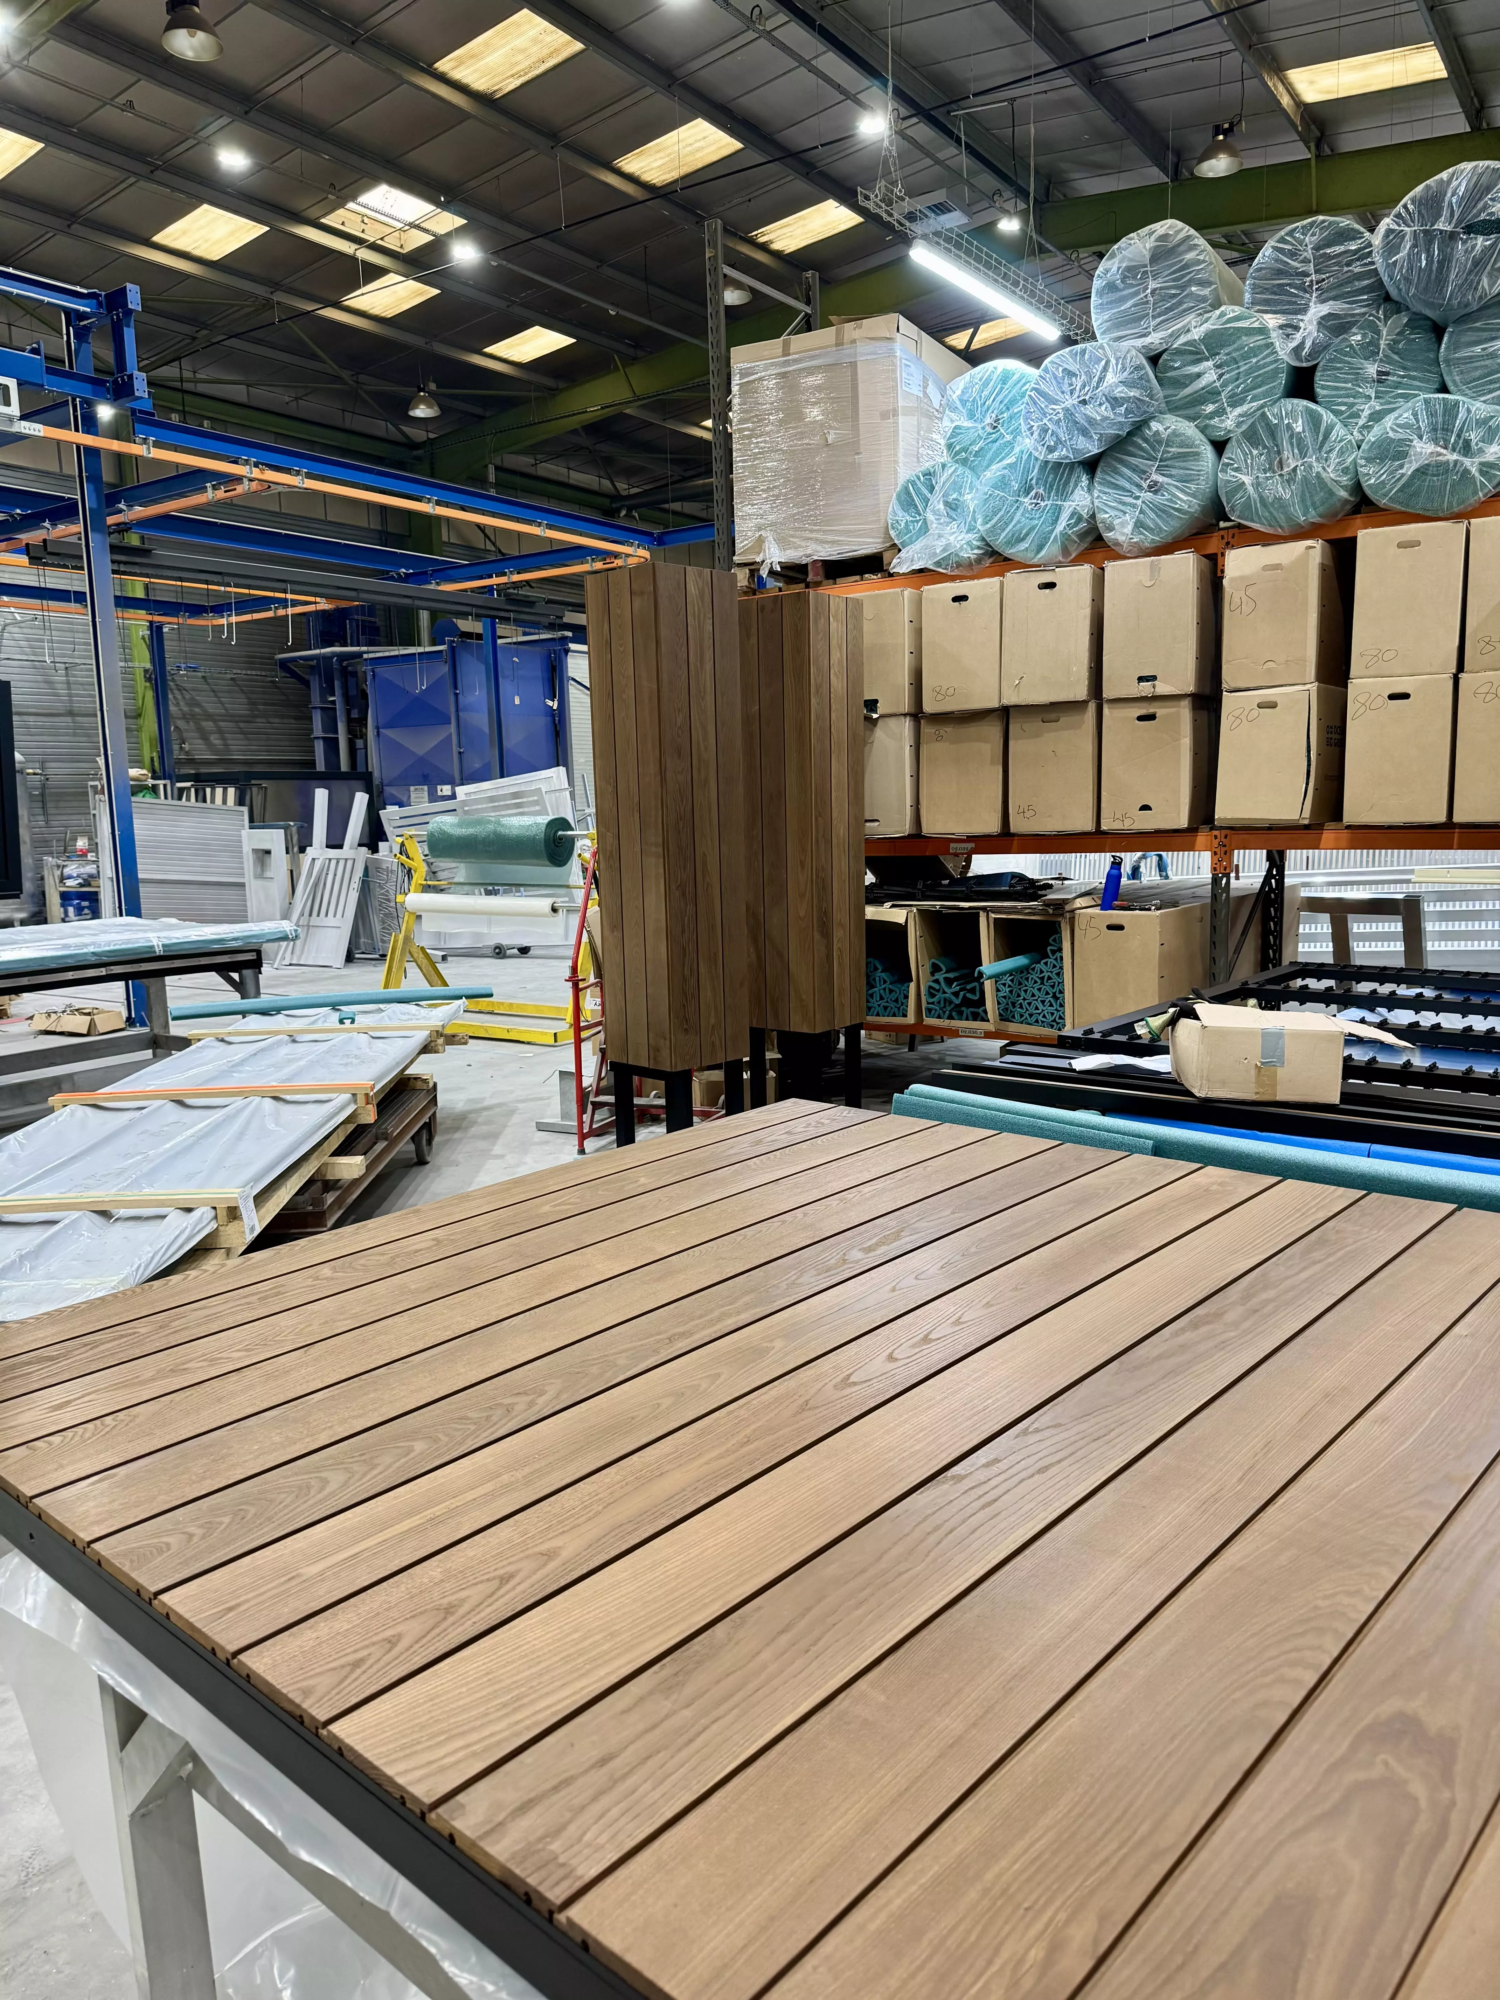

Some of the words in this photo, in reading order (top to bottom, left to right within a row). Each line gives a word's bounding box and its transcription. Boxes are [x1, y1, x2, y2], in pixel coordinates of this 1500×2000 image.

[1229, 582, 1257, 617] 45
[1478, 635, 1500, 655] 8
[1360, 648, 1398, 669] 80
[932, 685, 956, 702] 80
[1352, 692, 1388, 721] 80
[1226, 707, 1260, 731] 80
[1017, 805, 1037, 820] 45
[1112, 811, 1136, 828] 45
[1078, 913, 1101, 940] 45
